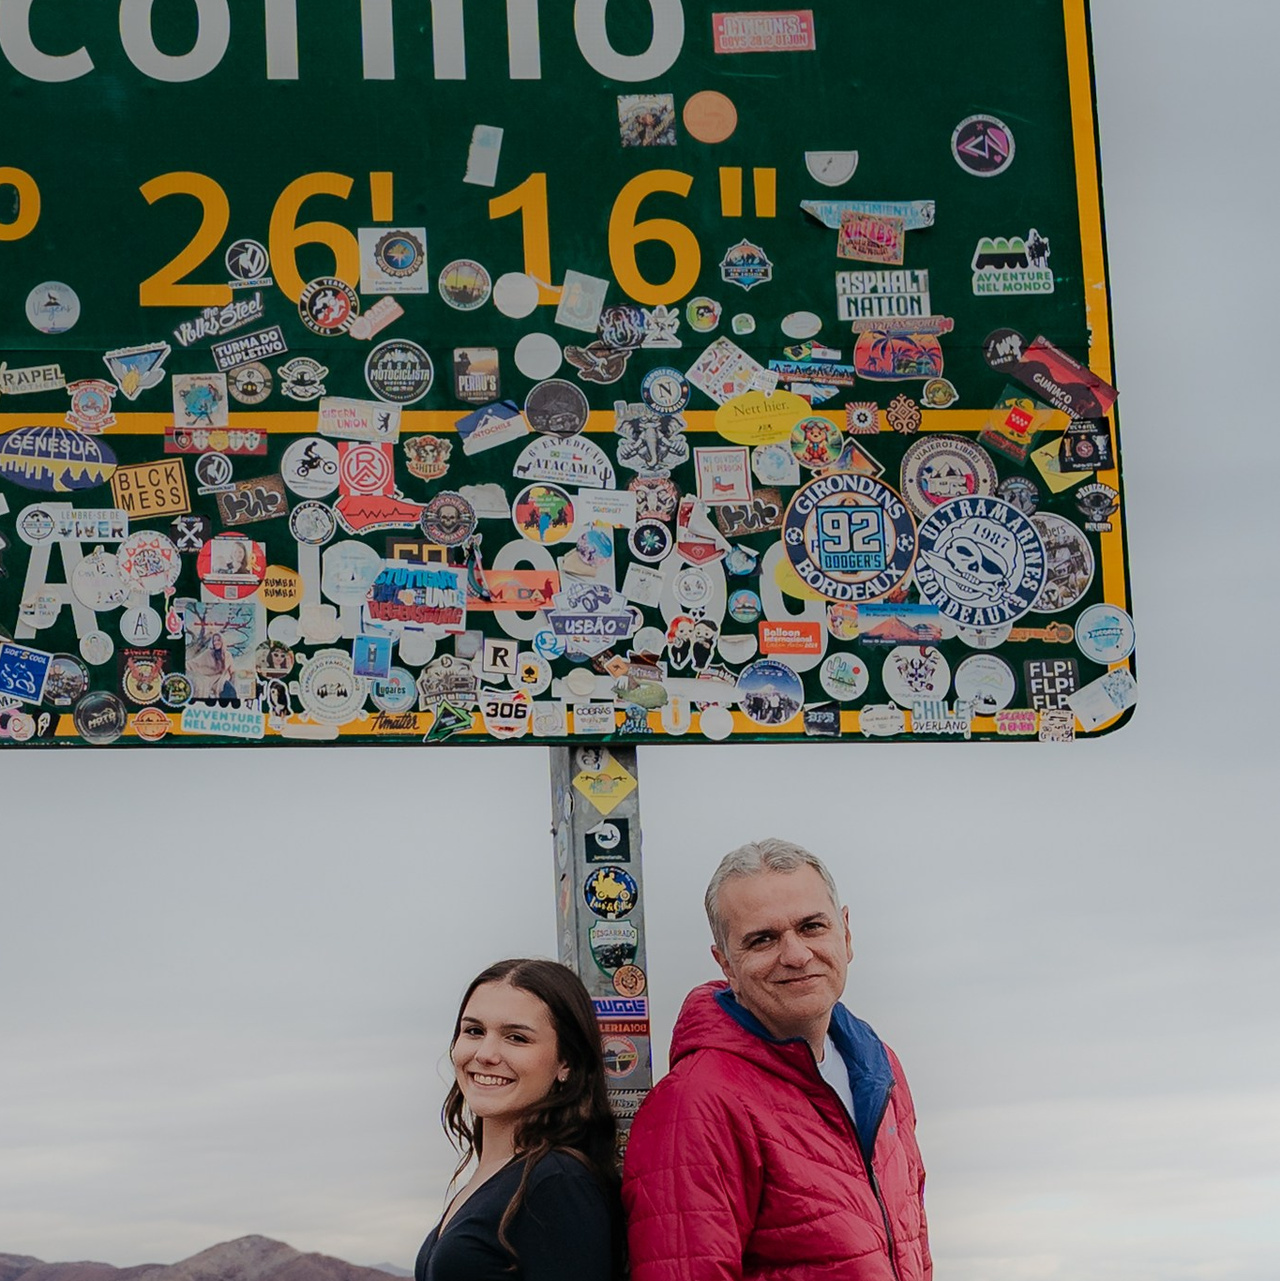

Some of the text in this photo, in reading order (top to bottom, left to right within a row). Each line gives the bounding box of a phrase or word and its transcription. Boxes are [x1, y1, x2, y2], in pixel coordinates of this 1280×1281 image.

[322, 280, 342, 290] TEAM
[836, 271, 928, 294] ASPHALT
[976, 272, 1051, 284] AVVENTURE
[976, 282, 1052, 293] NEL MONDO
[846, 295, 923, 317] NATION
[174, 291, 263, 346] Volks Steel
[216, 331, 279, 359] TURMA DO
[219, 341, 283, 368] SUPLETIVO
[371, 369, 430, 381] MOTOCICLISTA
[376, 361, 422, 370] CASAL
[2, 368, 66, 388] RAPEL
[657, 381, 672, 399] N
[1032, 373, 1073, 405] GUANACO
[651, 397, 686, 413] AUSTRALIA
[732, 400, 791, 418] Nett hier.
[336, 419, 368, 429] UNION
[7, 434, 99, 456] GENESUR
[540, 437, 606, 467] EXPEDIÇÃO
[914, 440, 982, 464] VIAJEROS LIBRES
[532, 457, 598, 476] ATACAMA
[119, 466, 177, 491] BLCK
[120, 488, 182, 513] MESS
[795, 475, 905, 519] GIRONDINS
[61, 510, 121, 521] LEMBRE-SE DE
[821, 510, 882, 553] 92
[971, 523, 1010, 549] 1987
[920, 499, 1041, 592] ULTRAMARINES
[825, 554, 883, 568] DODGER'S
[263, 578, 297, 588] RUMBA!
[374, 568, 460, 588] STUTTGART
[797, 562, 903, 602] BORDEAUX
[263, 588, 297, 598] RUMBA!
[920, 563, 1016, 626] BORDEAUX
[368, 600, 464, 625] REGENSBURG
[563, 618, 618, 636] USBÃO
[763, 628, 801, 637] Balloon
[491, 644, 510, 668] R
[1029, 661, 1072, 678] FLP!
[375, 681, 407, 697] Lugares
[1031, 677, 1075, 694] FLP!
[185, 708, 262, 725] AVVENTURE
[485, 701, 528, 720] 306
[575, 706, 612, 717] COBRAS
[911, 699, 970, 721] CHILE
[185, 720, 261, 735] NEL MONDO
[913, 720, 968, 733] OVERLAND
